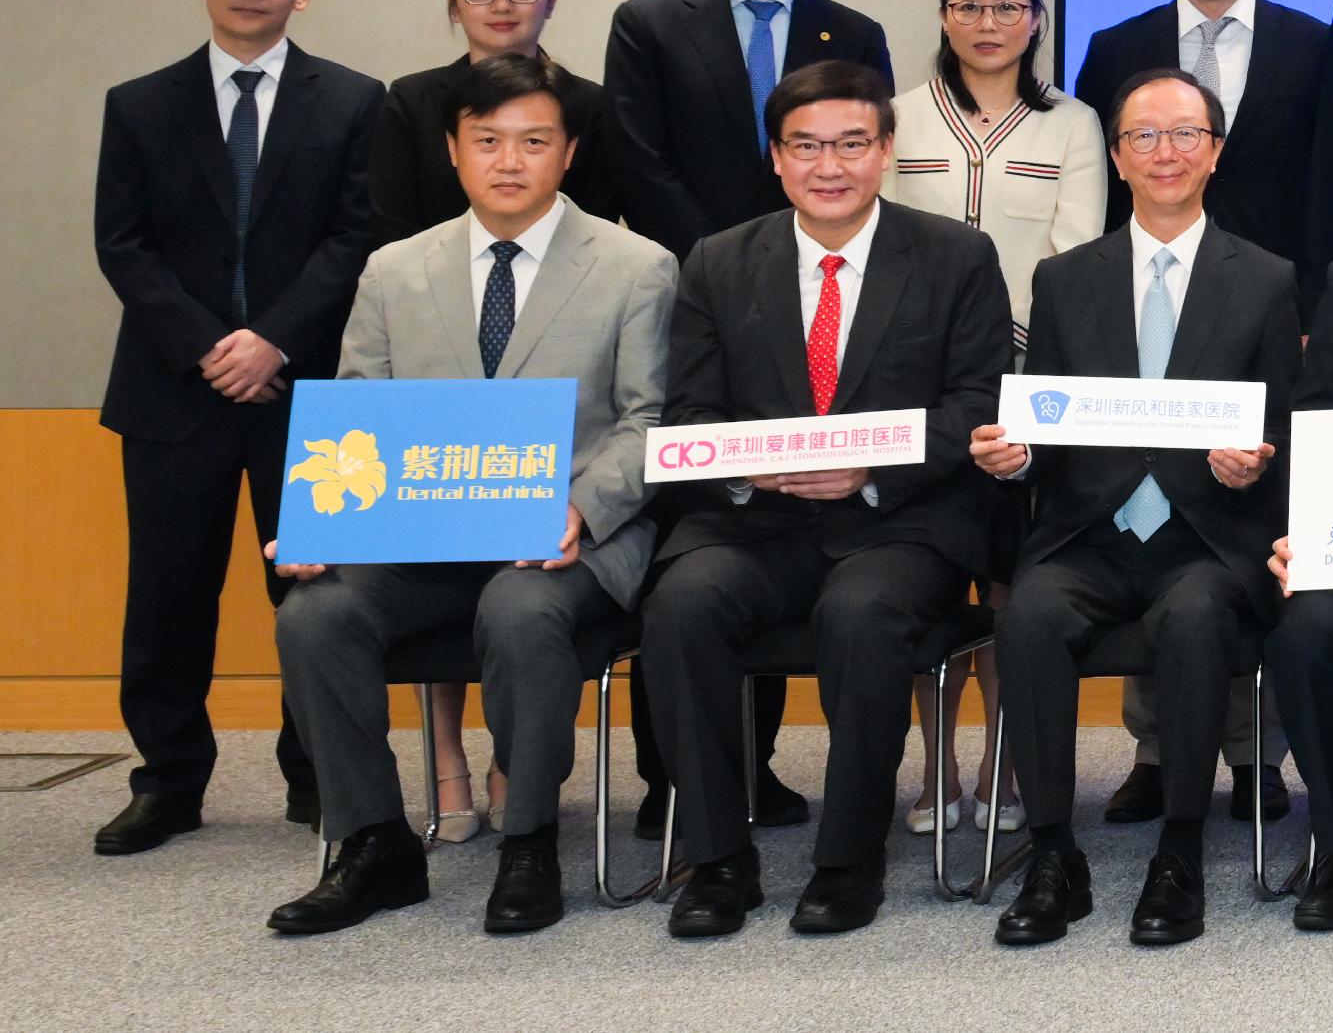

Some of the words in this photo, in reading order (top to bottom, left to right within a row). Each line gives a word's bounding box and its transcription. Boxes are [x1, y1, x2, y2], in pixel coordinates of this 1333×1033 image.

[1076, 397, 1240, 419] 深圳新风和睦家医院
[722, 425, 912, 456] 深圳爱康健口腔医院
[793, 449, 869, 460] STOMATOLOGICAL
[873, 446, 911, 454] HOSPITAL
[397, 486, 462, 500] Dental
[469, 485, 554, 499] Bauhinia
